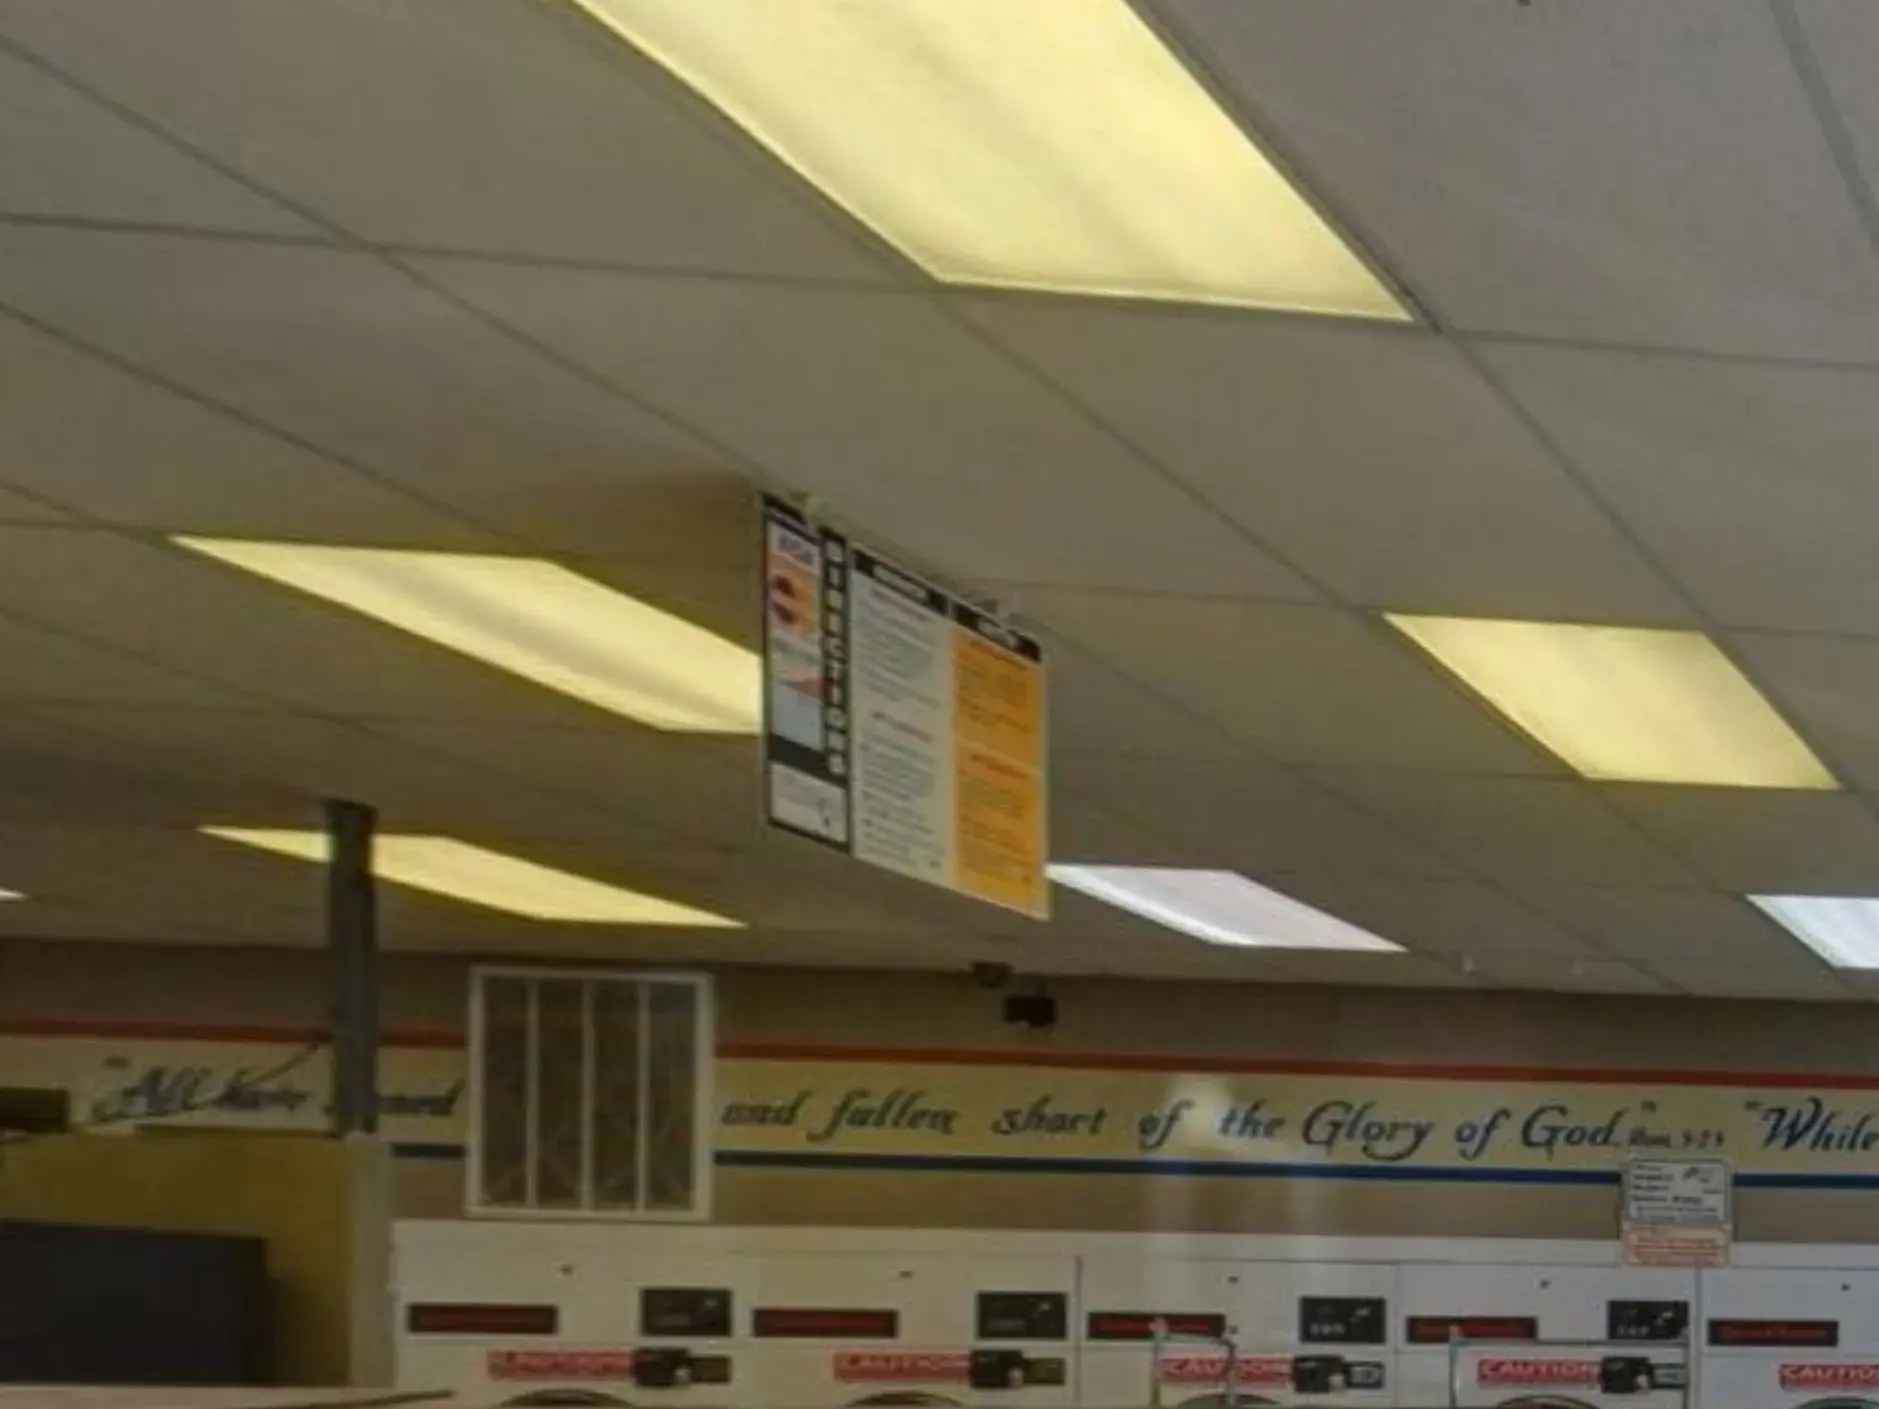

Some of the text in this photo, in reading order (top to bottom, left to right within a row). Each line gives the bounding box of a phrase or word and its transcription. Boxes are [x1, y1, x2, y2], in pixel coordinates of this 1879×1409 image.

[721, 1088, 813, 1127] and
[806, 1086, 962, 1144] fallen
[991, 1092, 1108, 1137] short
[1137, 1100, 1192, 1153] of
[1220, 1098, 1288, 1139] the
[1301, 1099, 1436, 1163] Glory
[1453, 1105, 1512, 1162] of
